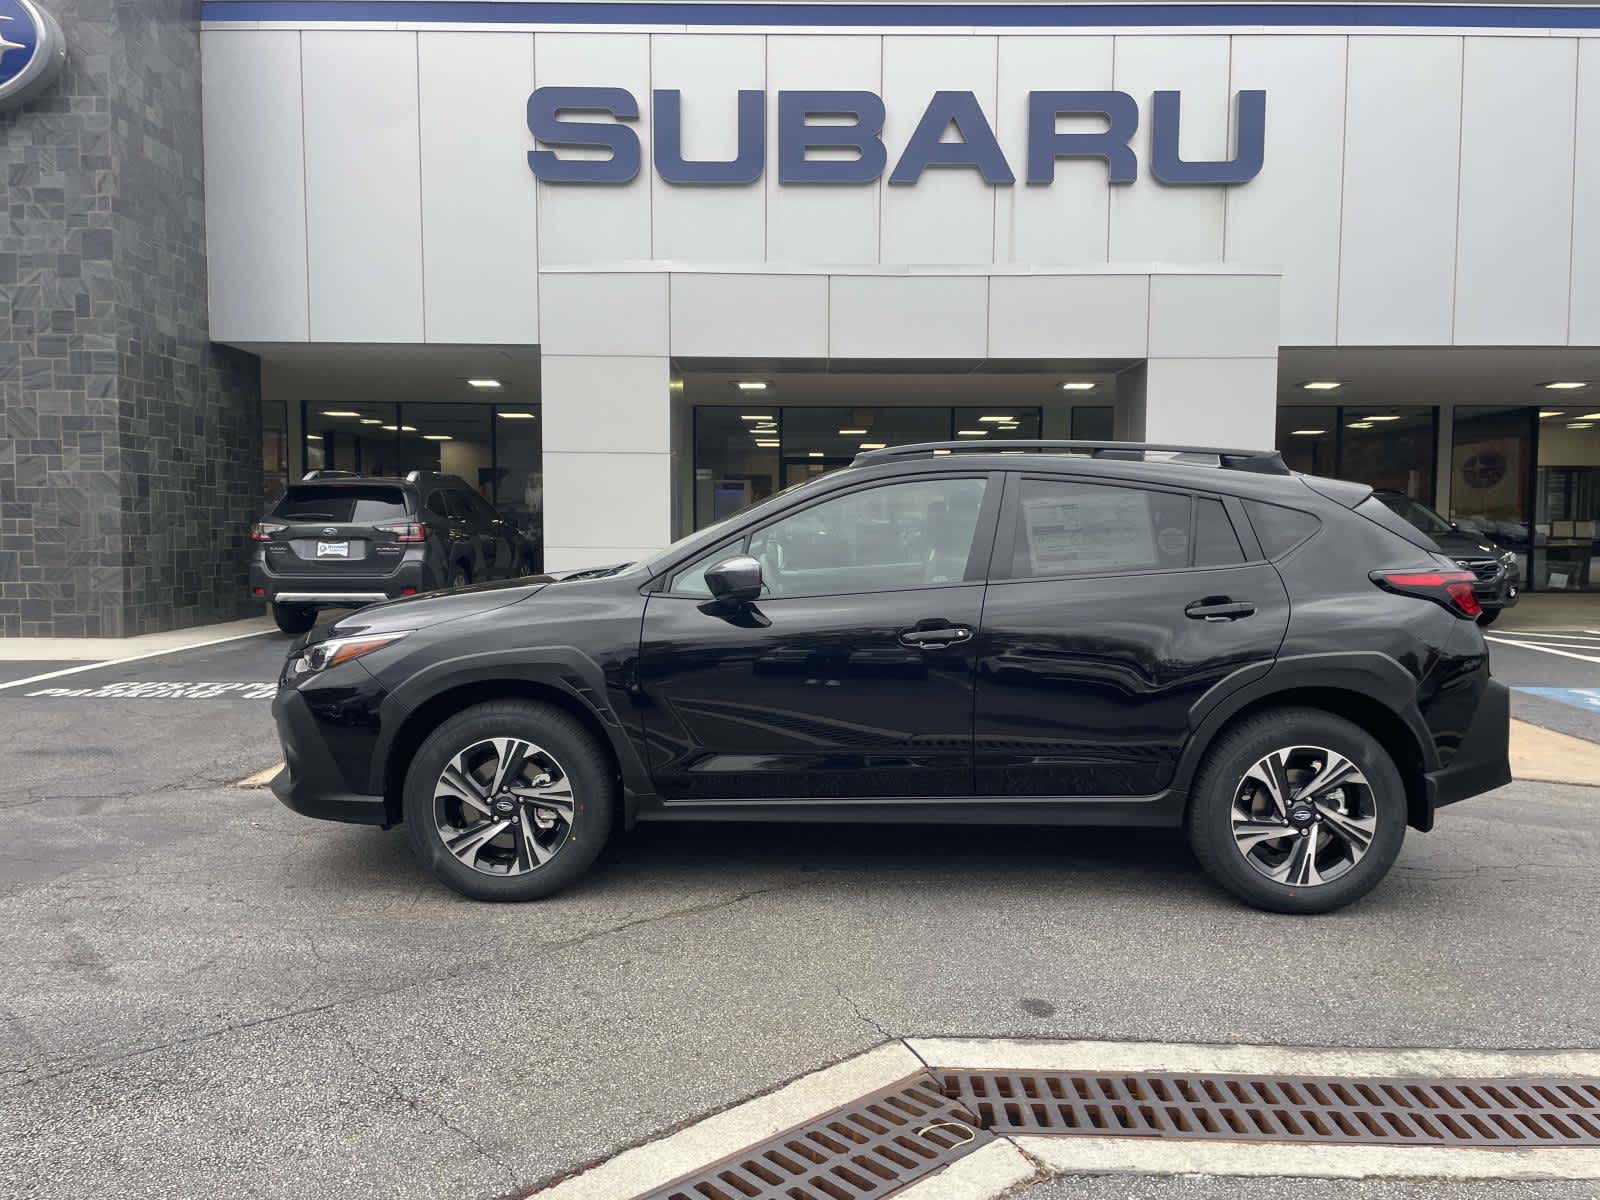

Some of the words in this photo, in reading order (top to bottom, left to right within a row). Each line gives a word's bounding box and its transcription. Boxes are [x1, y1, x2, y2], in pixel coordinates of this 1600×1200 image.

[527, 86, 1267, 187] SUBARU
[101, 681, 279, 691] CUSTOM
[24, 688, 225, 698] PARKING
